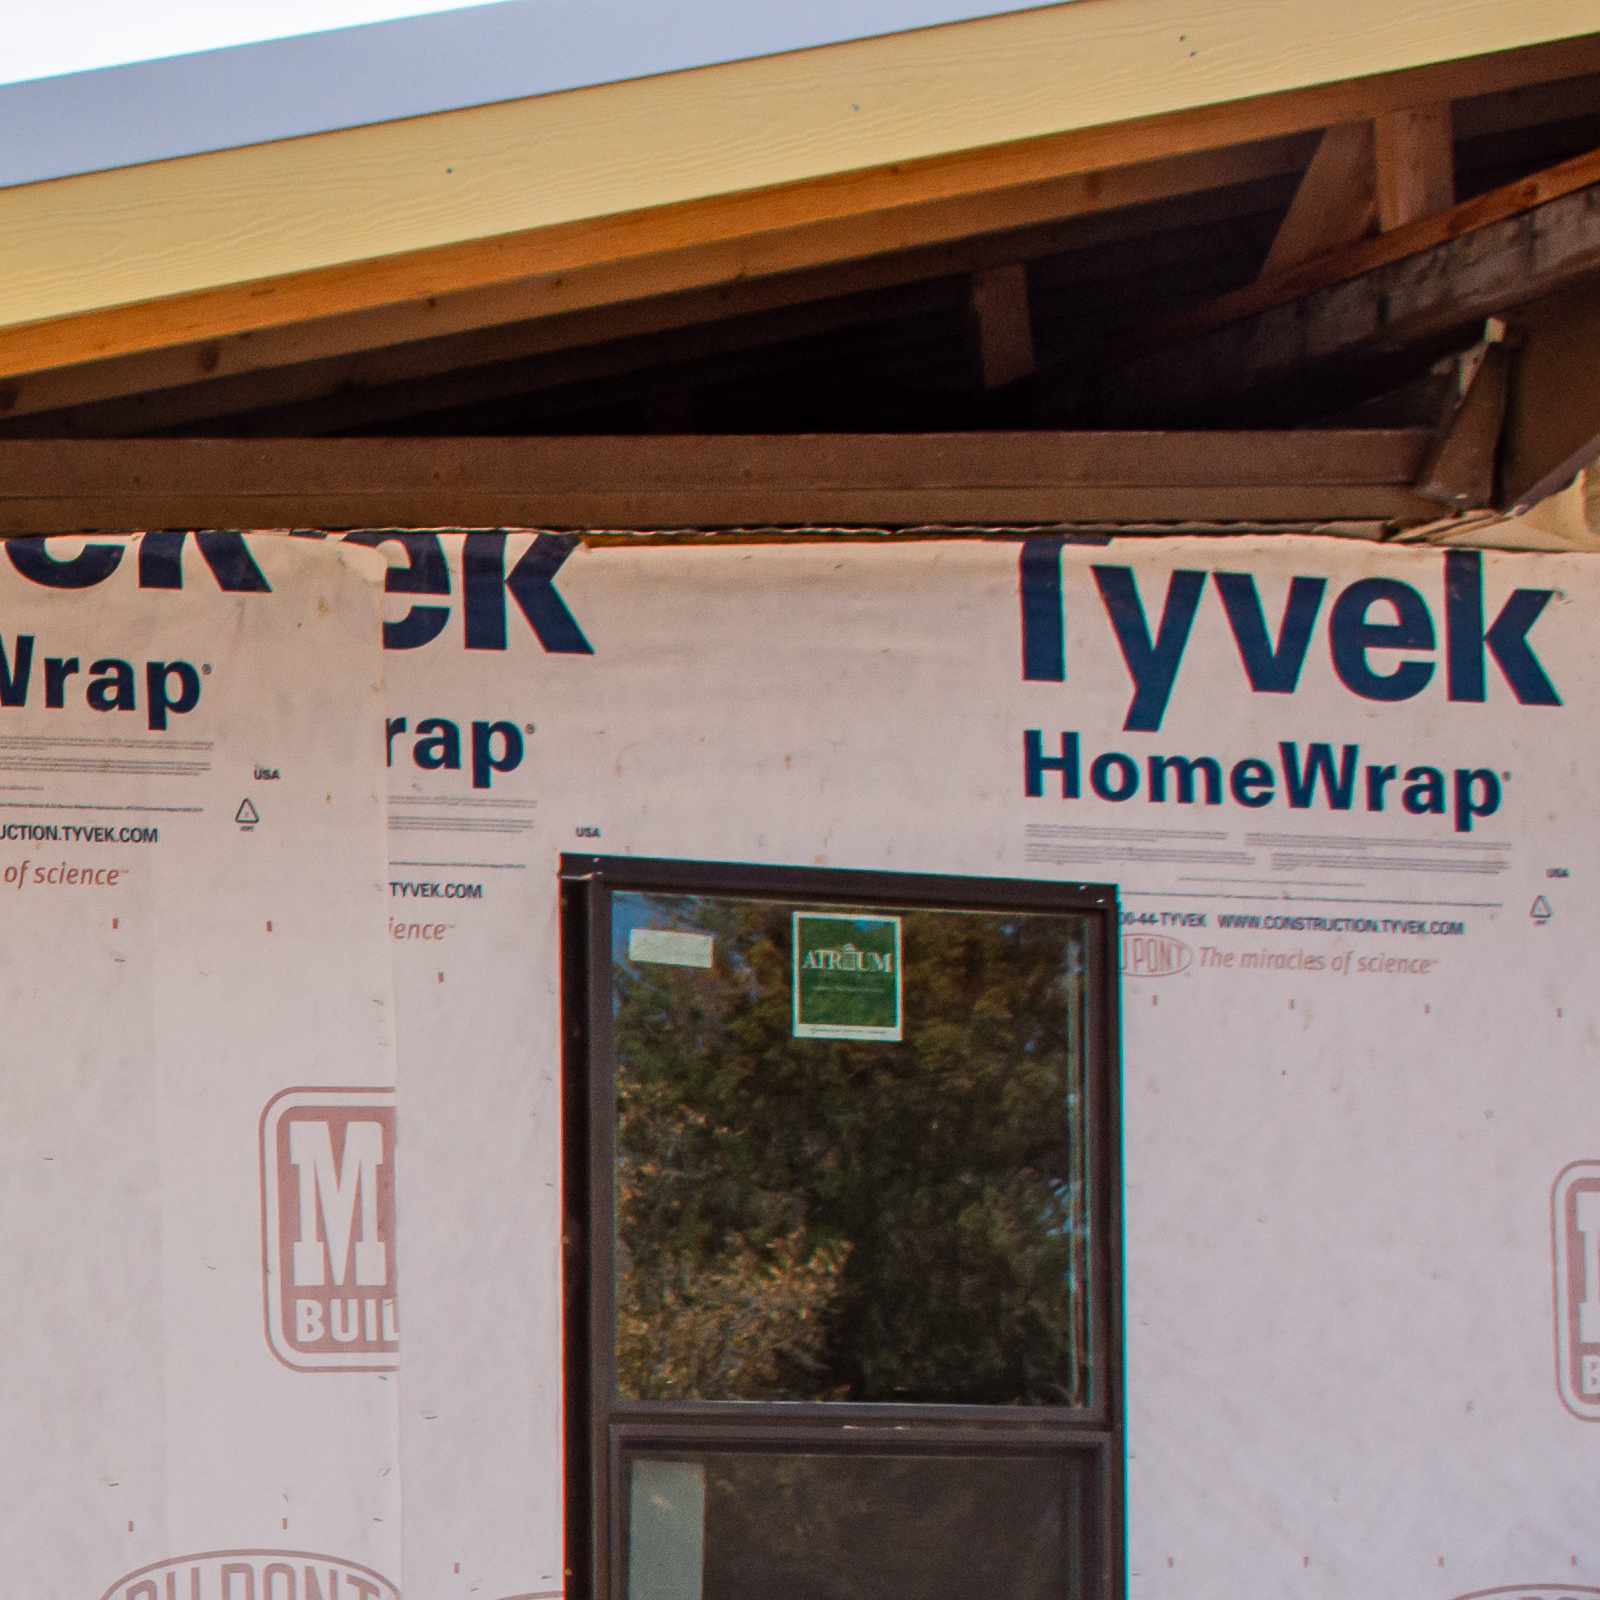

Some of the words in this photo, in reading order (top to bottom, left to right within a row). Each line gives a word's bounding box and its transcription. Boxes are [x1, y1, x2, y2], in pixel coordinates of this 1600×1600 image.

[983, 537, 1565, 732] Tyvek
[253, 768, 280, 780] USA
[1023, 729, 1503, 832] HomeWrap
[576, 826, 601, 838] USA
[3, 860, 31, 891] of
[33, 862, 119, 886] science
[1217, 914, 1464, 936] WWW.CONSTRUCTION.TYVEK.COM
[1200, 946, 1234, 969] The
[1239, 948, 1326, 972] miracles
[1330, 950, 1353, 976] of
[1356, 952, 1432, 976] science
